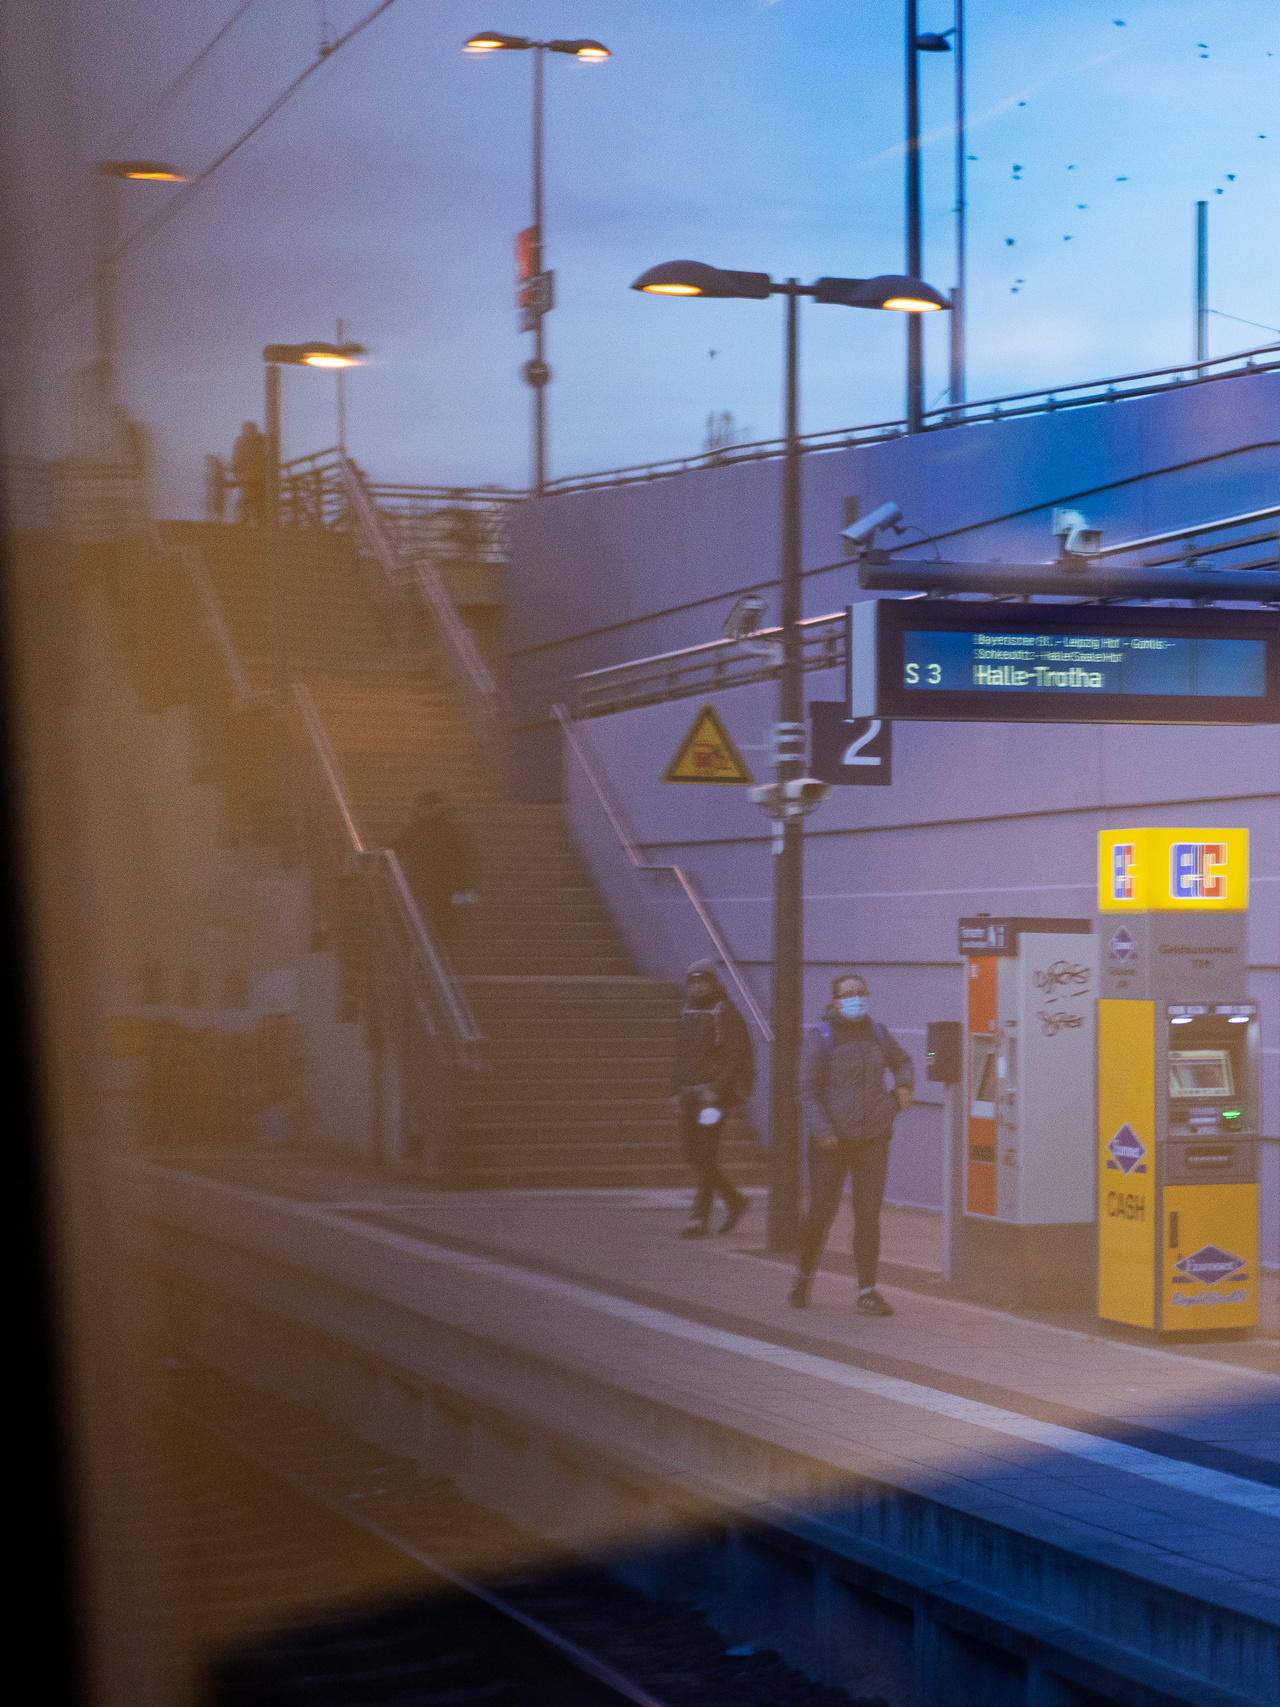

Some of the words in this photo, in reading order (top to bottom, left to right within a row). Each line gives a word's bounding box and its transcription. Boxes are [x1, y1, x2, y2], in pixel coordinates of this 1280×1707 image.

[905, 662, 919, 684] S
[926, 663, 942, 684] 3
[972, 664, 1104, 688] Halle-Trotha
[842, 719, 882, 766] 2
[1107, 1191, 1145, 1221] CASH
